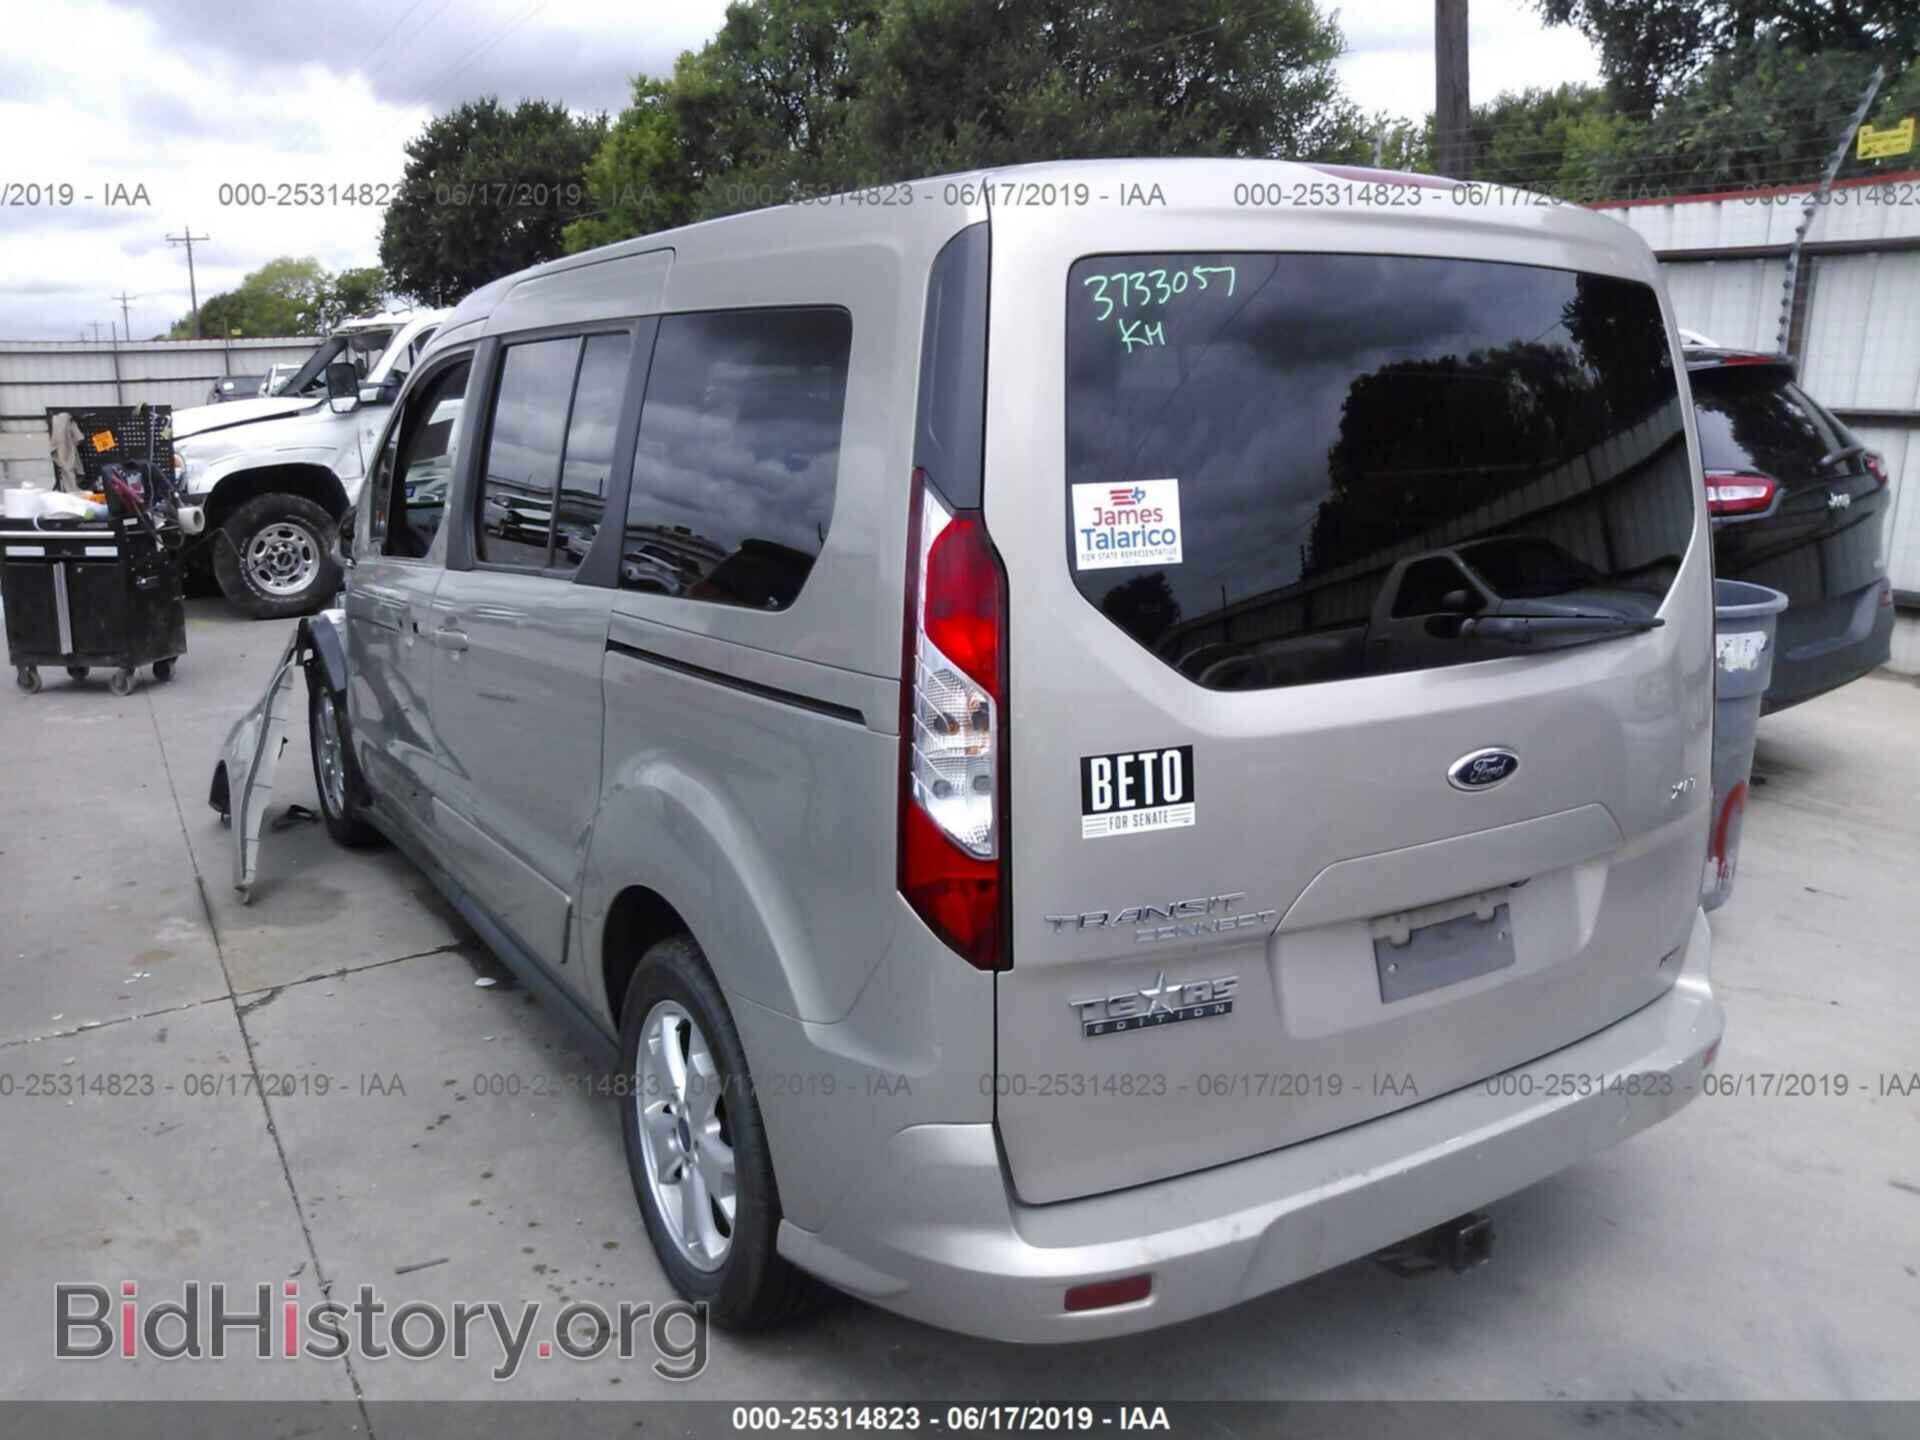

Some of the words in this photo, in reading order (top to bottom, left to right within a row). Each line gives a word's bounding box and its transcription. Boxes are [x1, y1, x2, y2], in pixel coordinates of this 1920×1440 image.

[1084, 265, 1236, 321] 3733057
[1092, 506, 1164, 526] James
[1080, 524, 1177, 551] Talarico
[1090, 749, 1183, 811] BETO
[1109, 815, 1128, 830] FOR
[1132, 809, 1169, 827] SENATE
[1045, 891, 1247, 933] TRANSIT
